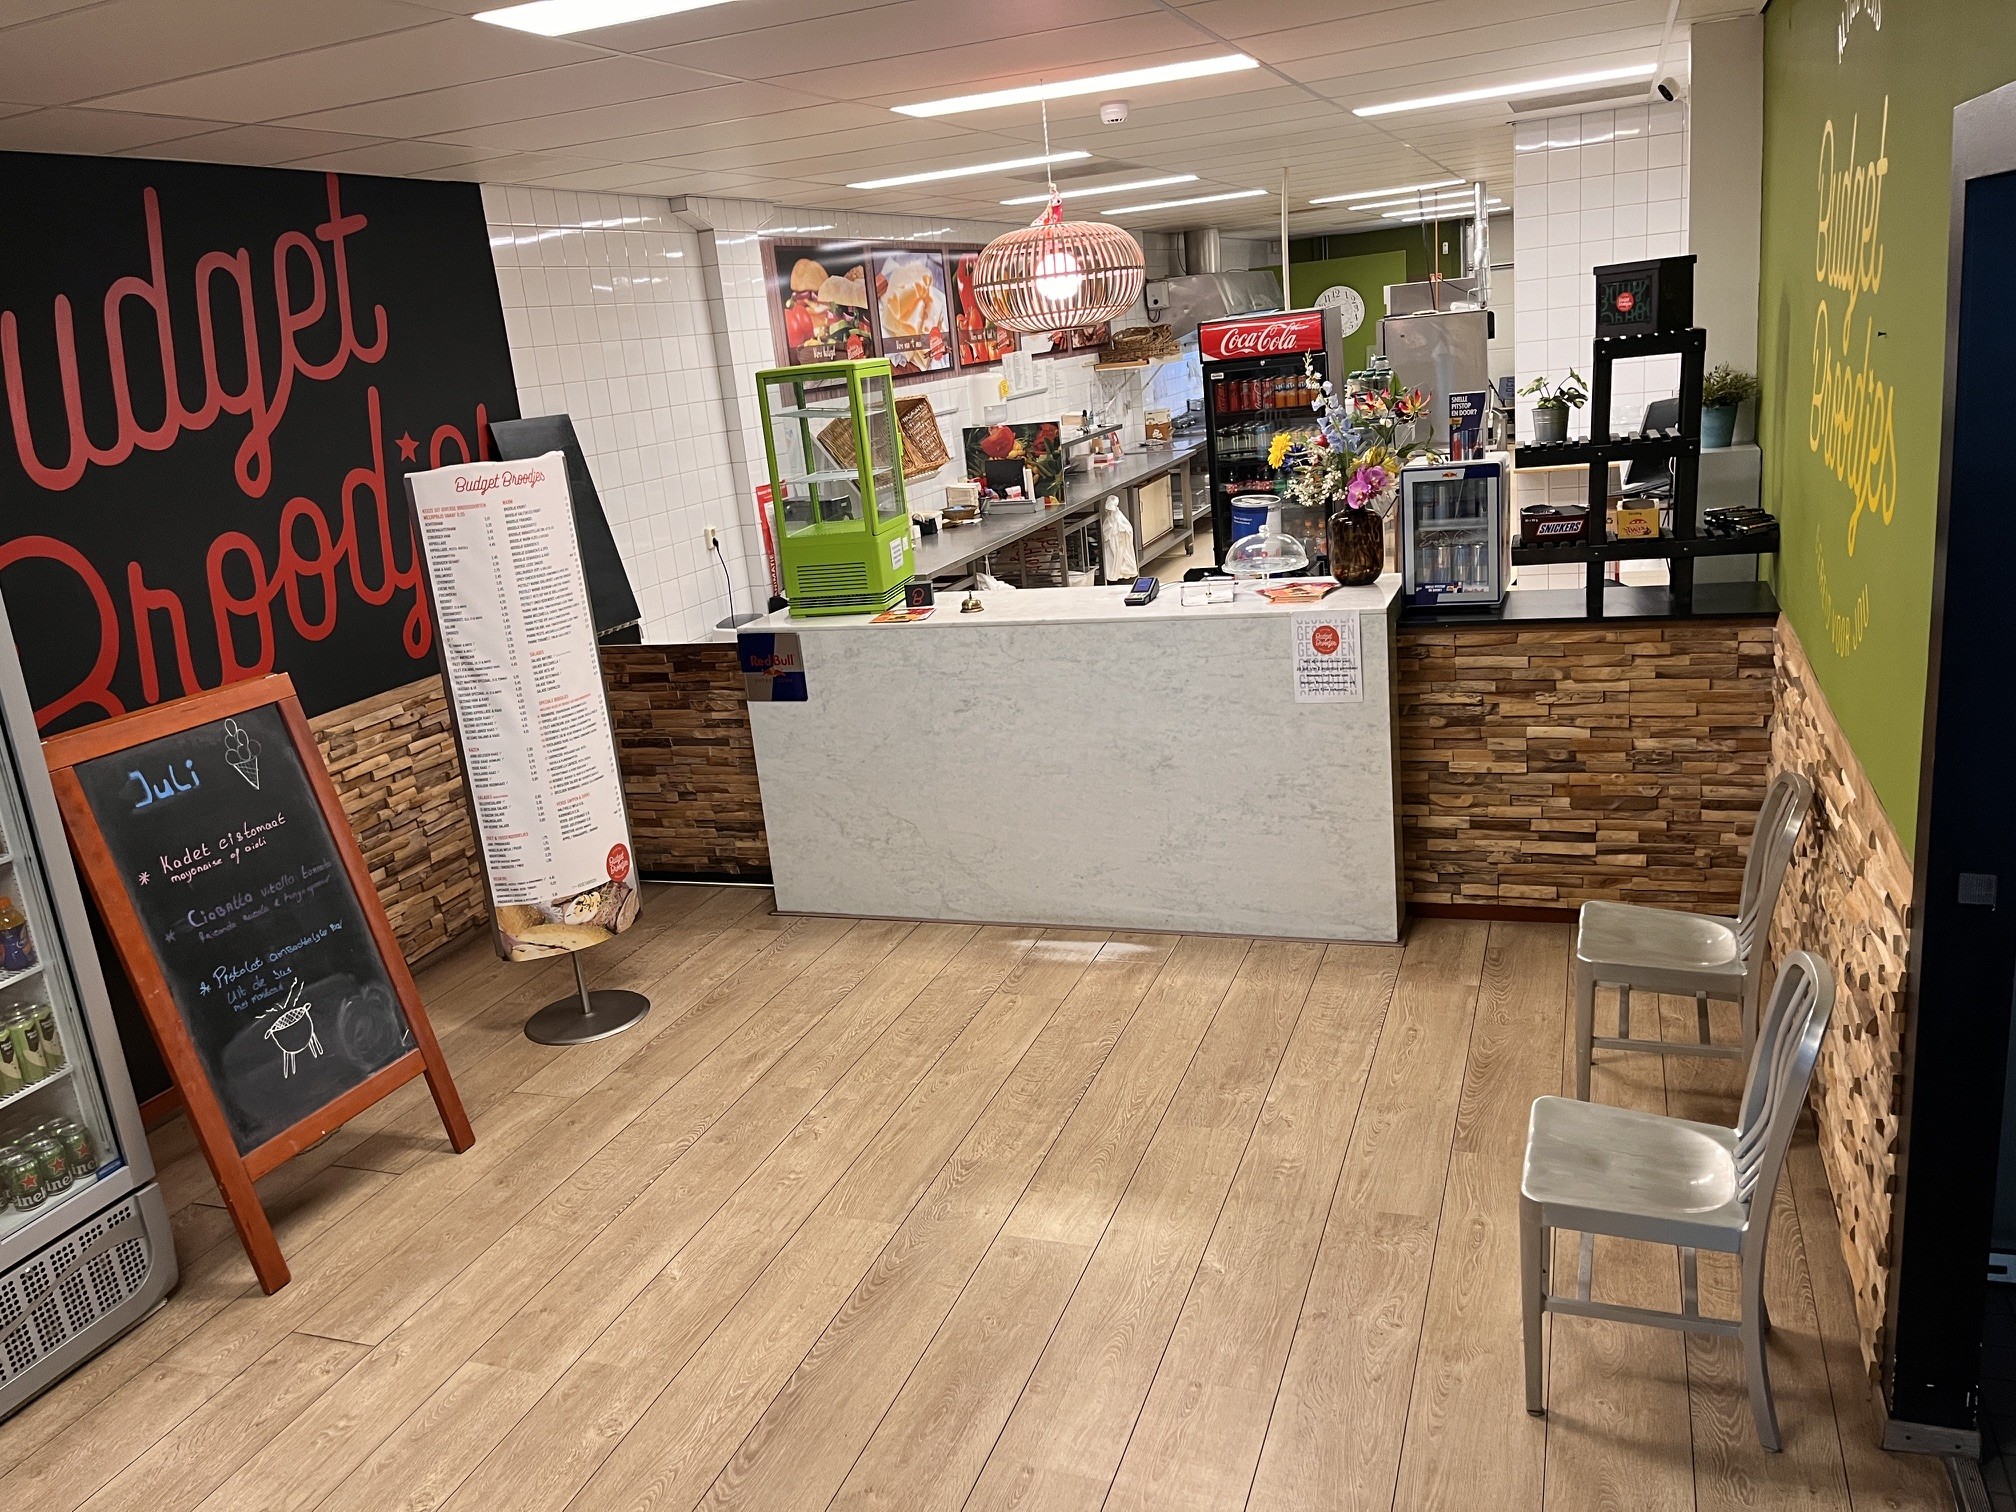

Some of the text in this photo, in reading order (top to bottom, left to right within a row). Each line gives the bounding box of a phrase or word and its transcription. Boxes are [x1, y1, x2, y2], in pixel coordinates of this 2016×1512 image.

[1816, 95, 1888, 356] Budget
[1220, 322, 1309, 356] Coca-Cola
[1451, 395, 1468, 403] SNELLE
[1451, 402, 1472, 410] PITSTOP
[1460, 408, 1478, 416] DOOR?
[1810, 300, 1896, 557] Broodjes
[455, 468, 546, 495] Budget Broodjes
[1539, 522, 1580, 534] SNICKERS
[1832, 583, 1869, 657] VOOR JOU
[750, 654, 794, 666] Red Bull
[160, 842, 211, 874] Kadet
[171, 836, 267, 883] mayonaise of aioli
[212, 957, 264, 989] Pistolet
[252, 974, 267, 991] de
